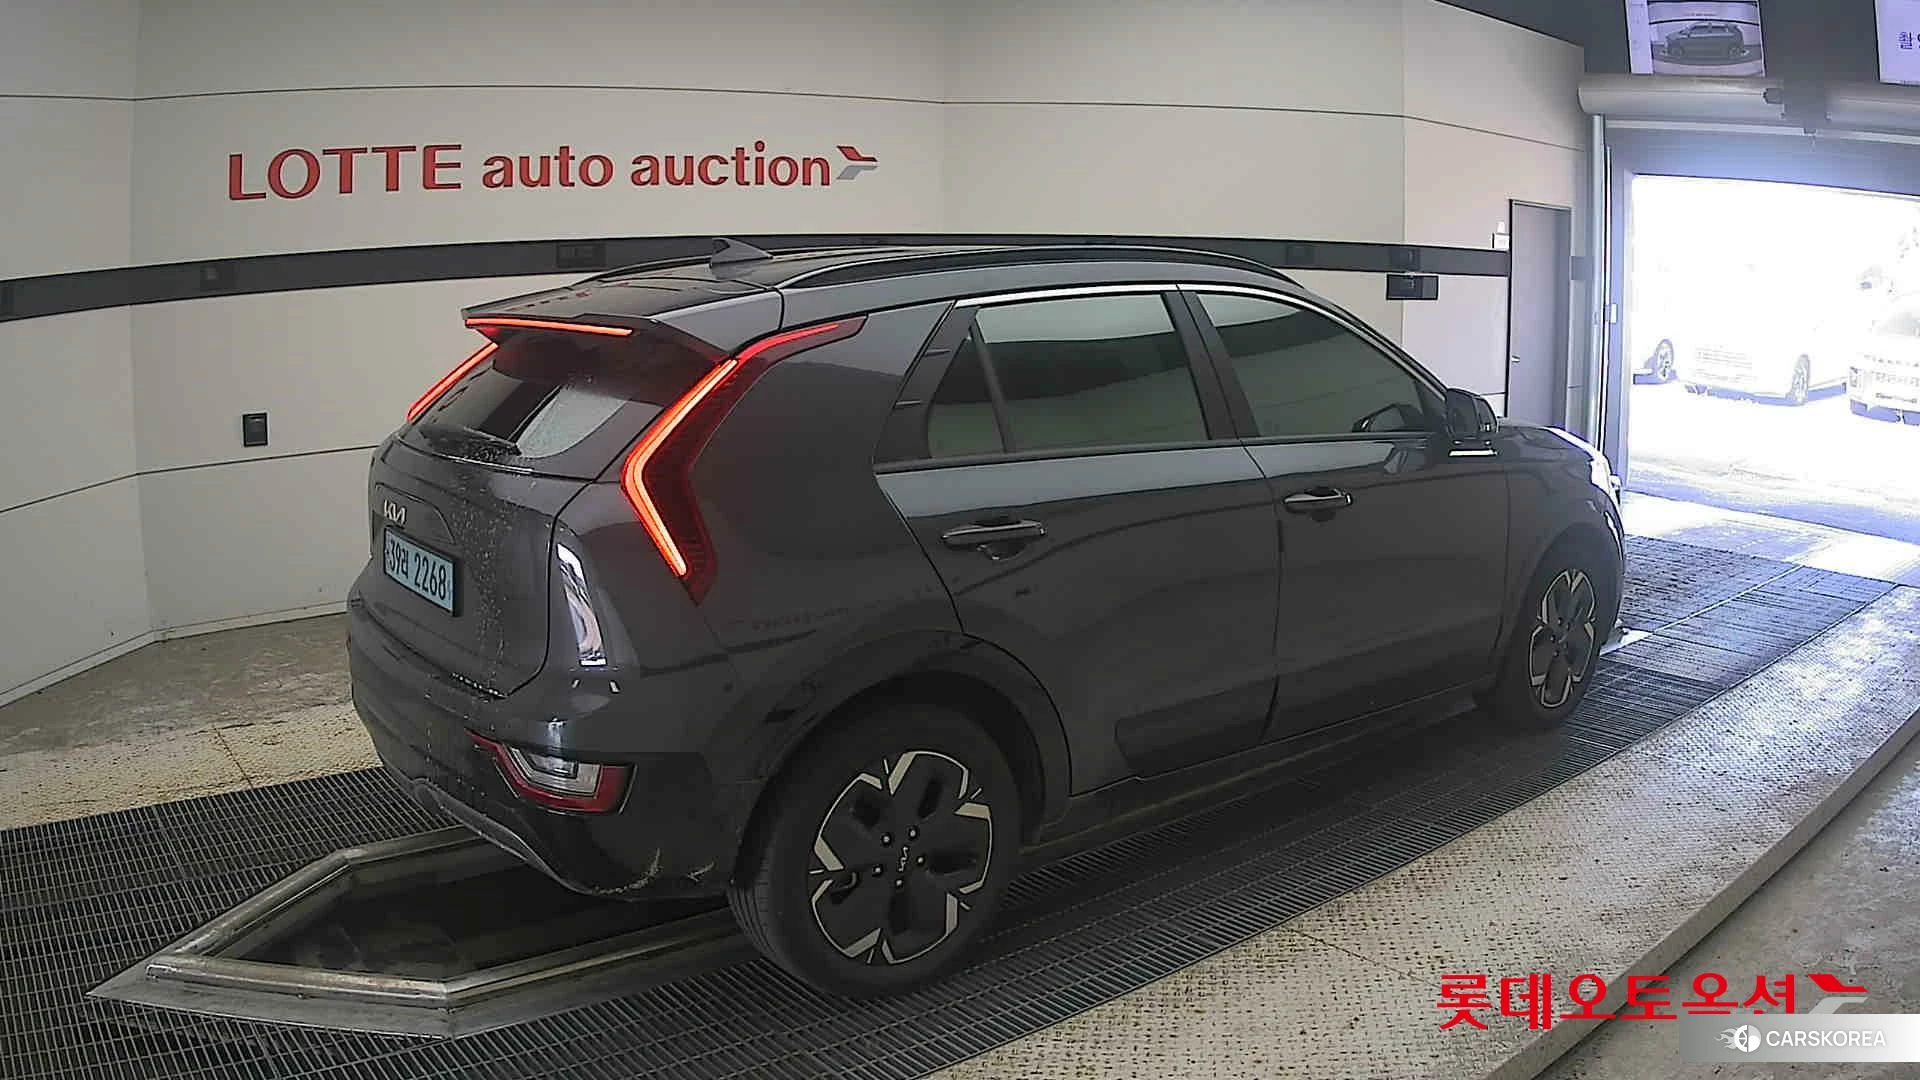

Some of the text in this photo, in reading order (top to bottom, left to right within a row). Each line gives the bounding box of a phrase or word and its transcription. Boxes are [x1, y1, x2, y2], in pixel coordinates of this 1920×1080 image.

[228, 140, 831, 201] LOTTE auto auction
[383, 499, 406, 525] KIA
[414, 552, 447, 601] 2268
